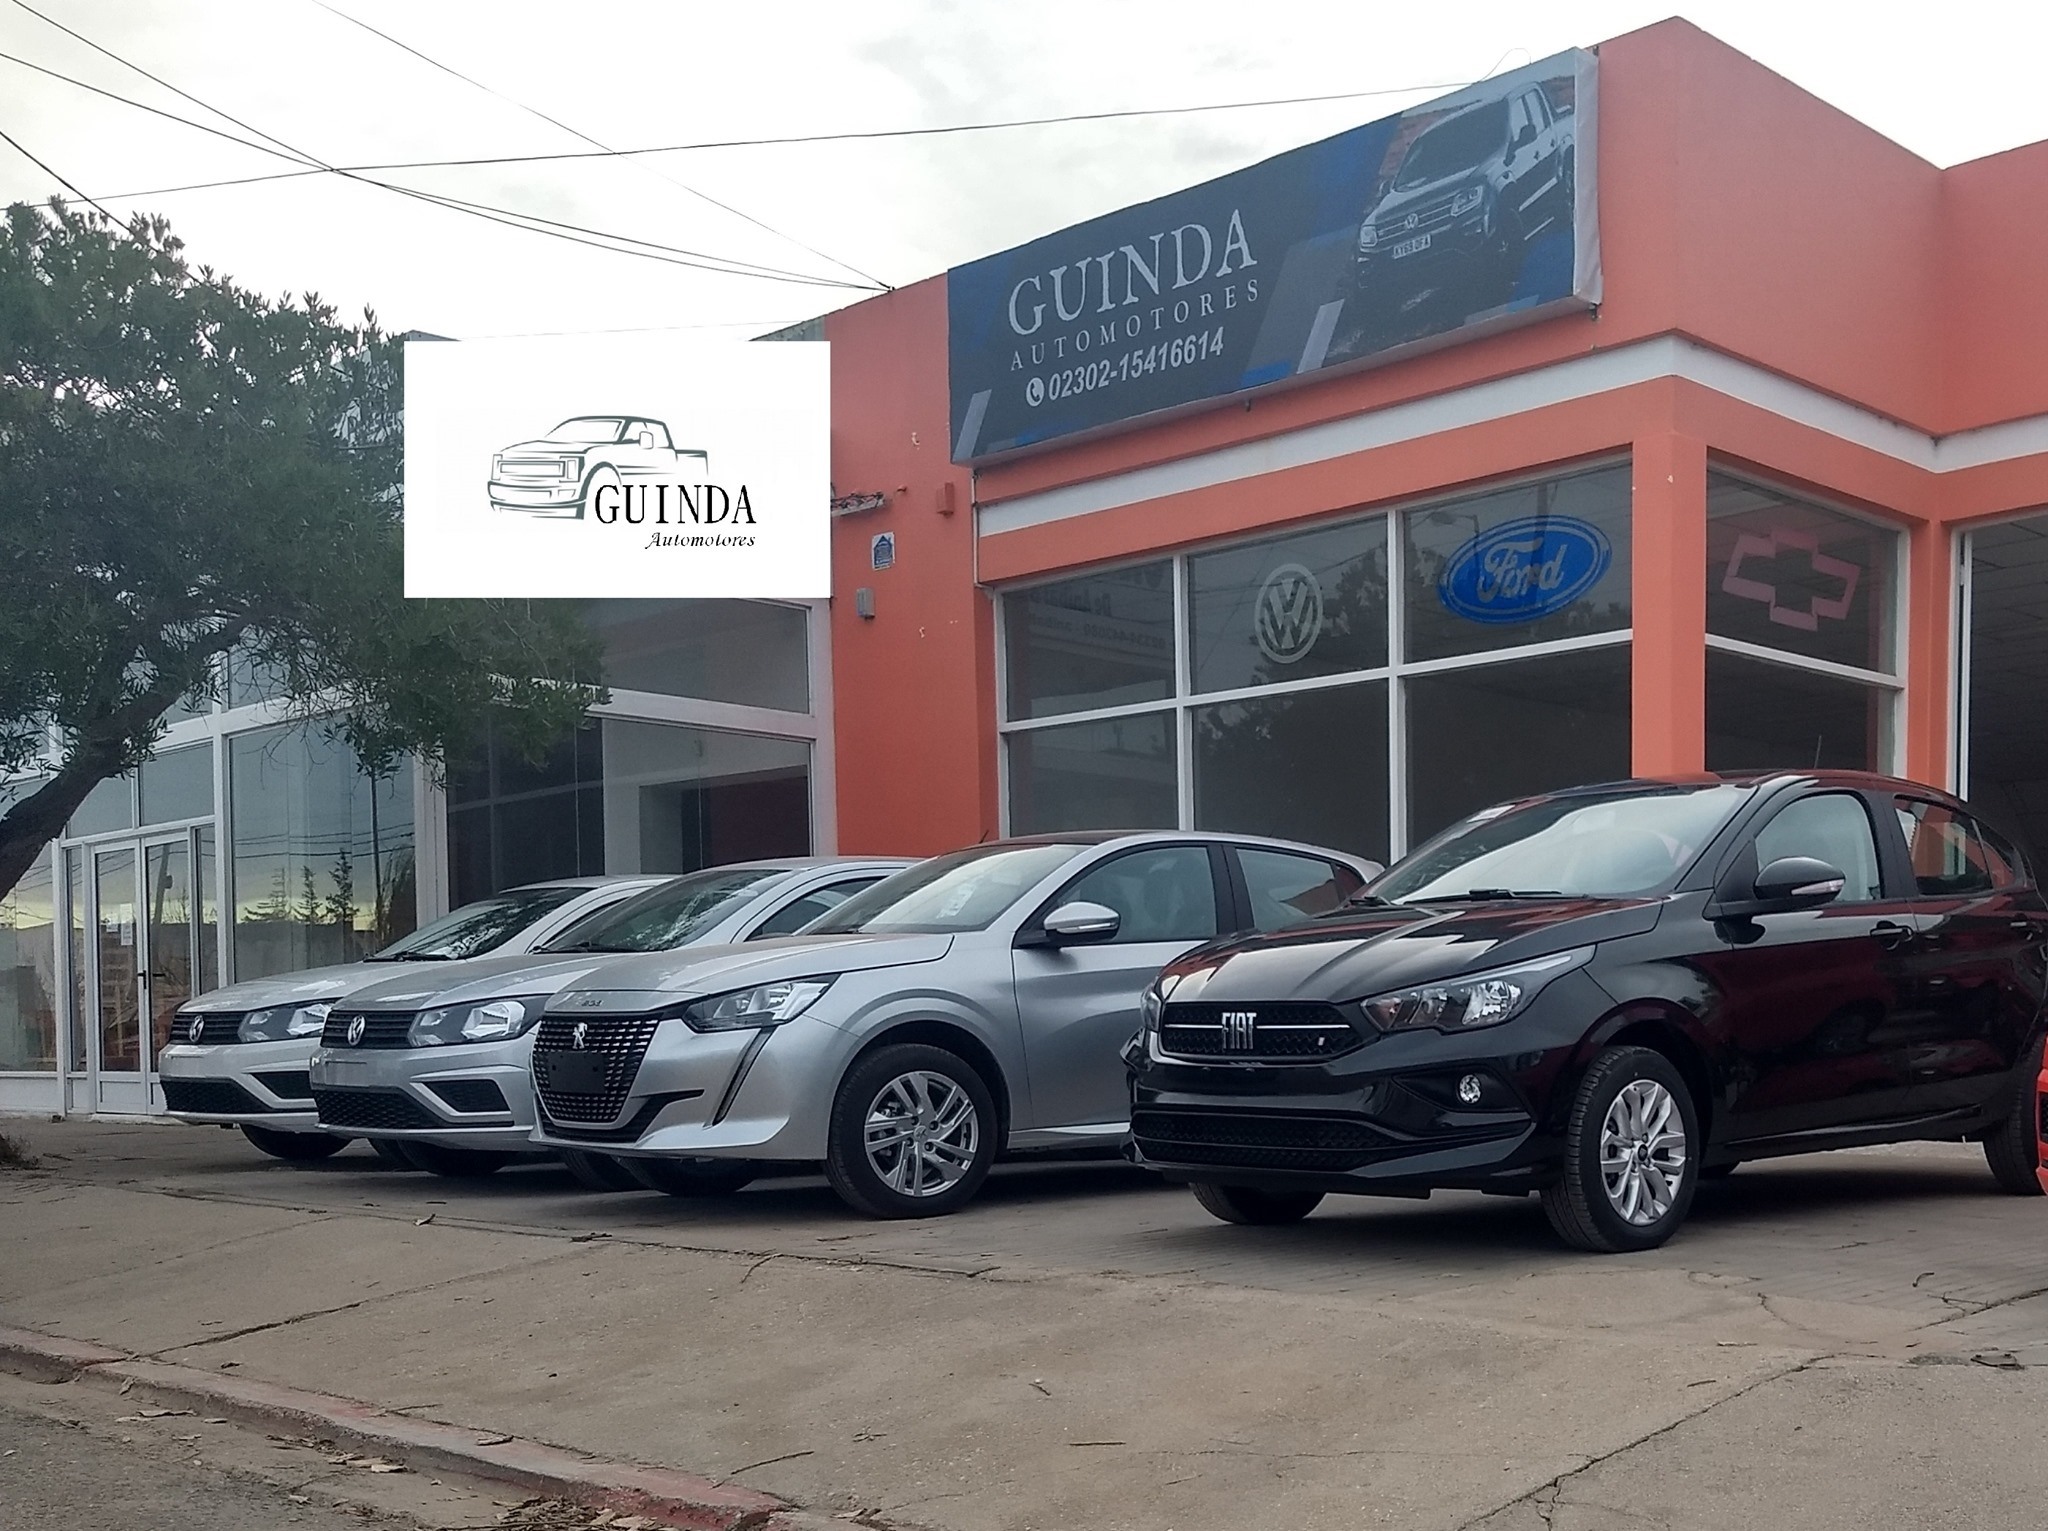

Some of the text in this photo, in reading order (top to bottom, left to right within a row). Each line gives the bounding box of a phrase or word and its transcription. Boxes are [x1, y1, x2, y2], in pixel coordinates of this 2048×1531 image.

[1008, 208, 1258, 336] GUINDA
[1010, 278, 1259, 372] AUTOMOTORES
[1049, 326, 1225, 401] 02302-15416614
[1477, 537, 1567, 603] Ford
[1222, 1012, 1257, 1050] FIAT
